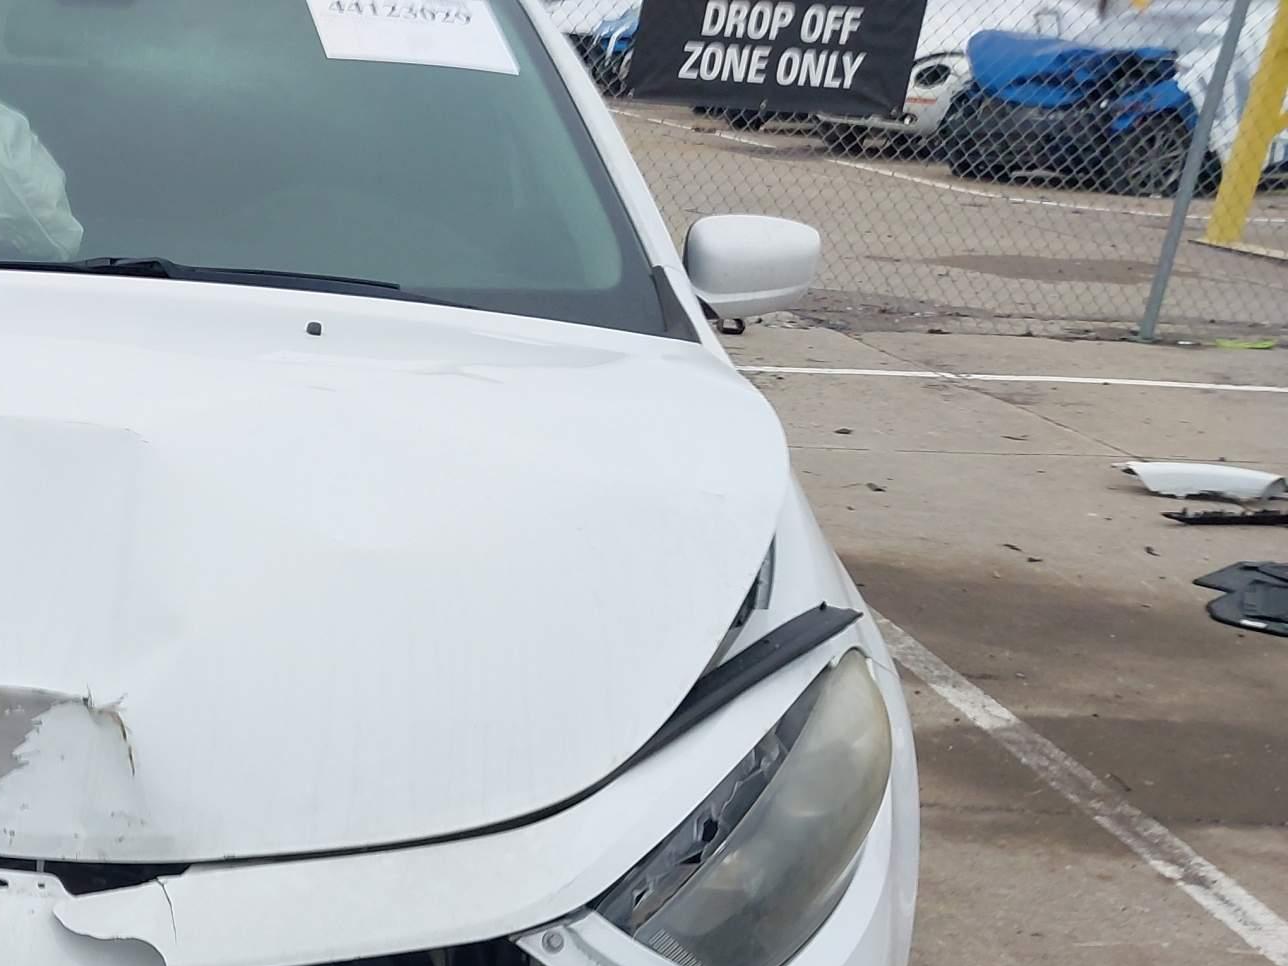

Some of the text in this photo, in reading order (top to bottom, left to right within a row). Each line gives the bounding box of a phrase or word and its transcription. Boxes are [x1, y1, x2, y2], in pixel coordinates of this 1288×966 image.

[701, 0, 864, 45] DROP OFF
[677, 40, 867, 89] ZONE ONLY
